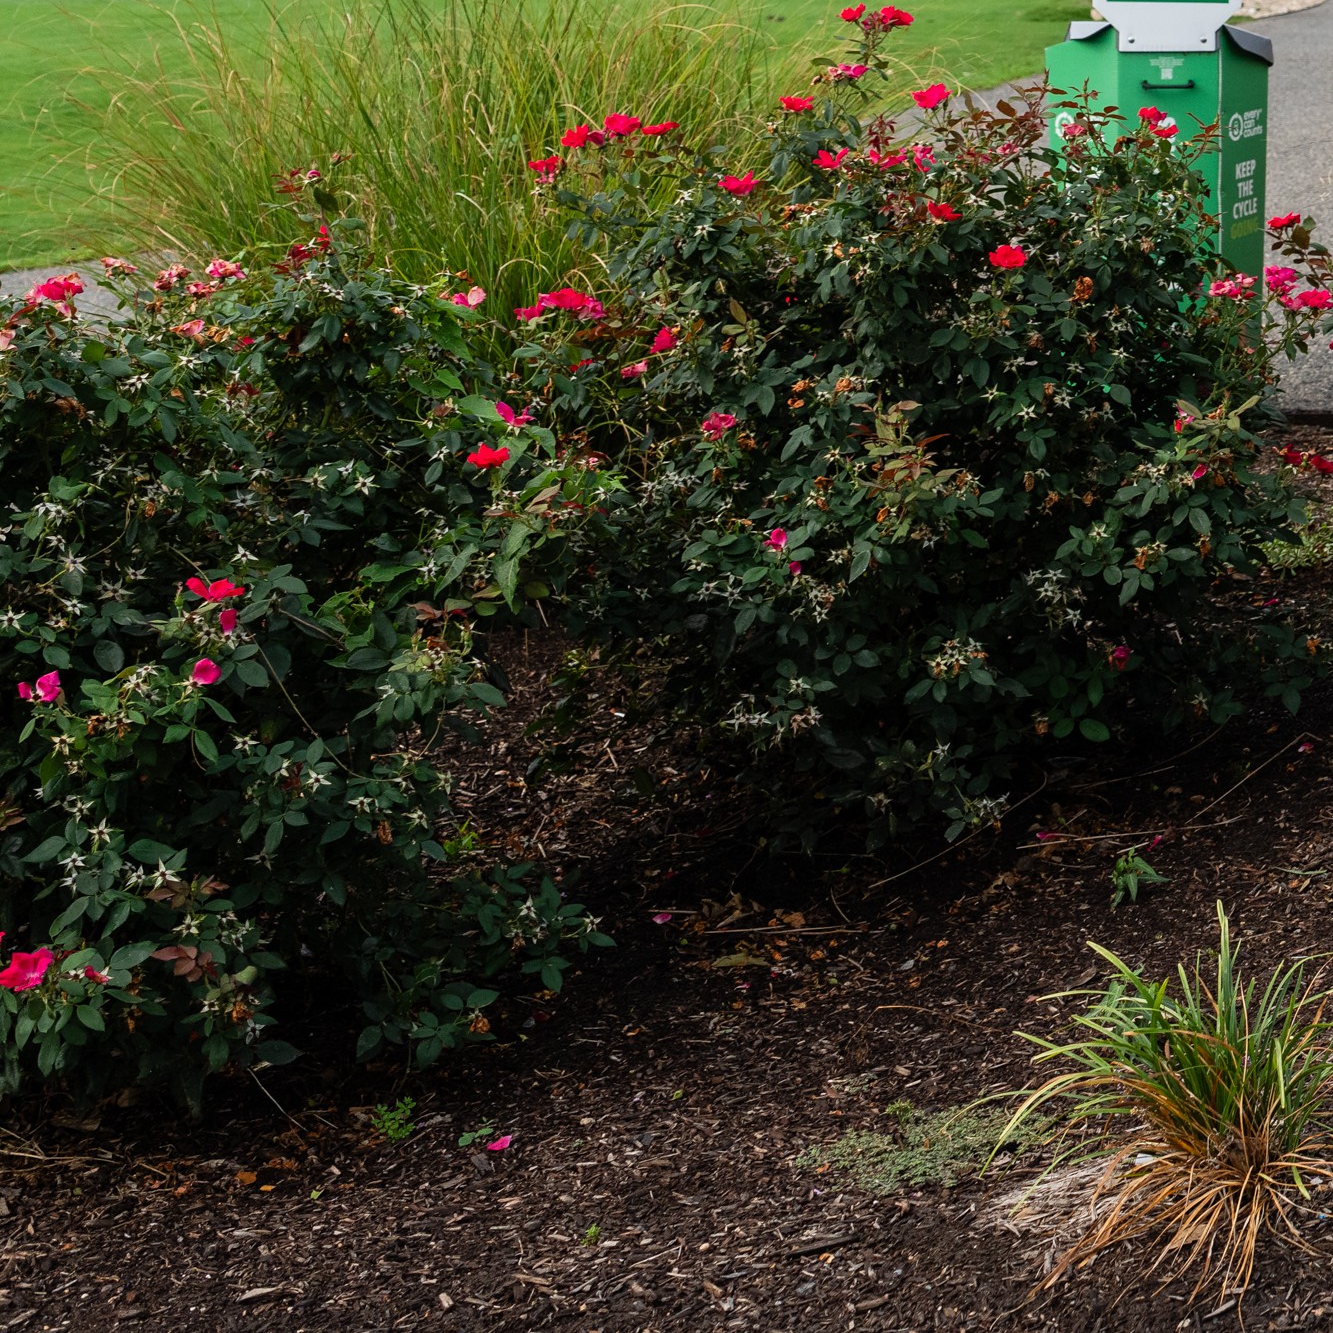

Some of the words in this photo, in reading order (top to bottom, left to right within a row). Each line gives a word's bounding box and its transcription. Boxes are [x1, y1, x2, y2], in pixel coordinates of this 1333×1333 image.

[1244, 109, 1260, 120] every
[1244, 119, 1255, 129] can
[1244, 124, 1263, 138] counts
[1236, 159, 1256, 180] KEEP
[1237, 179, 1253, 198] THE
[1233, 197, 1258, 219] CYCLE
